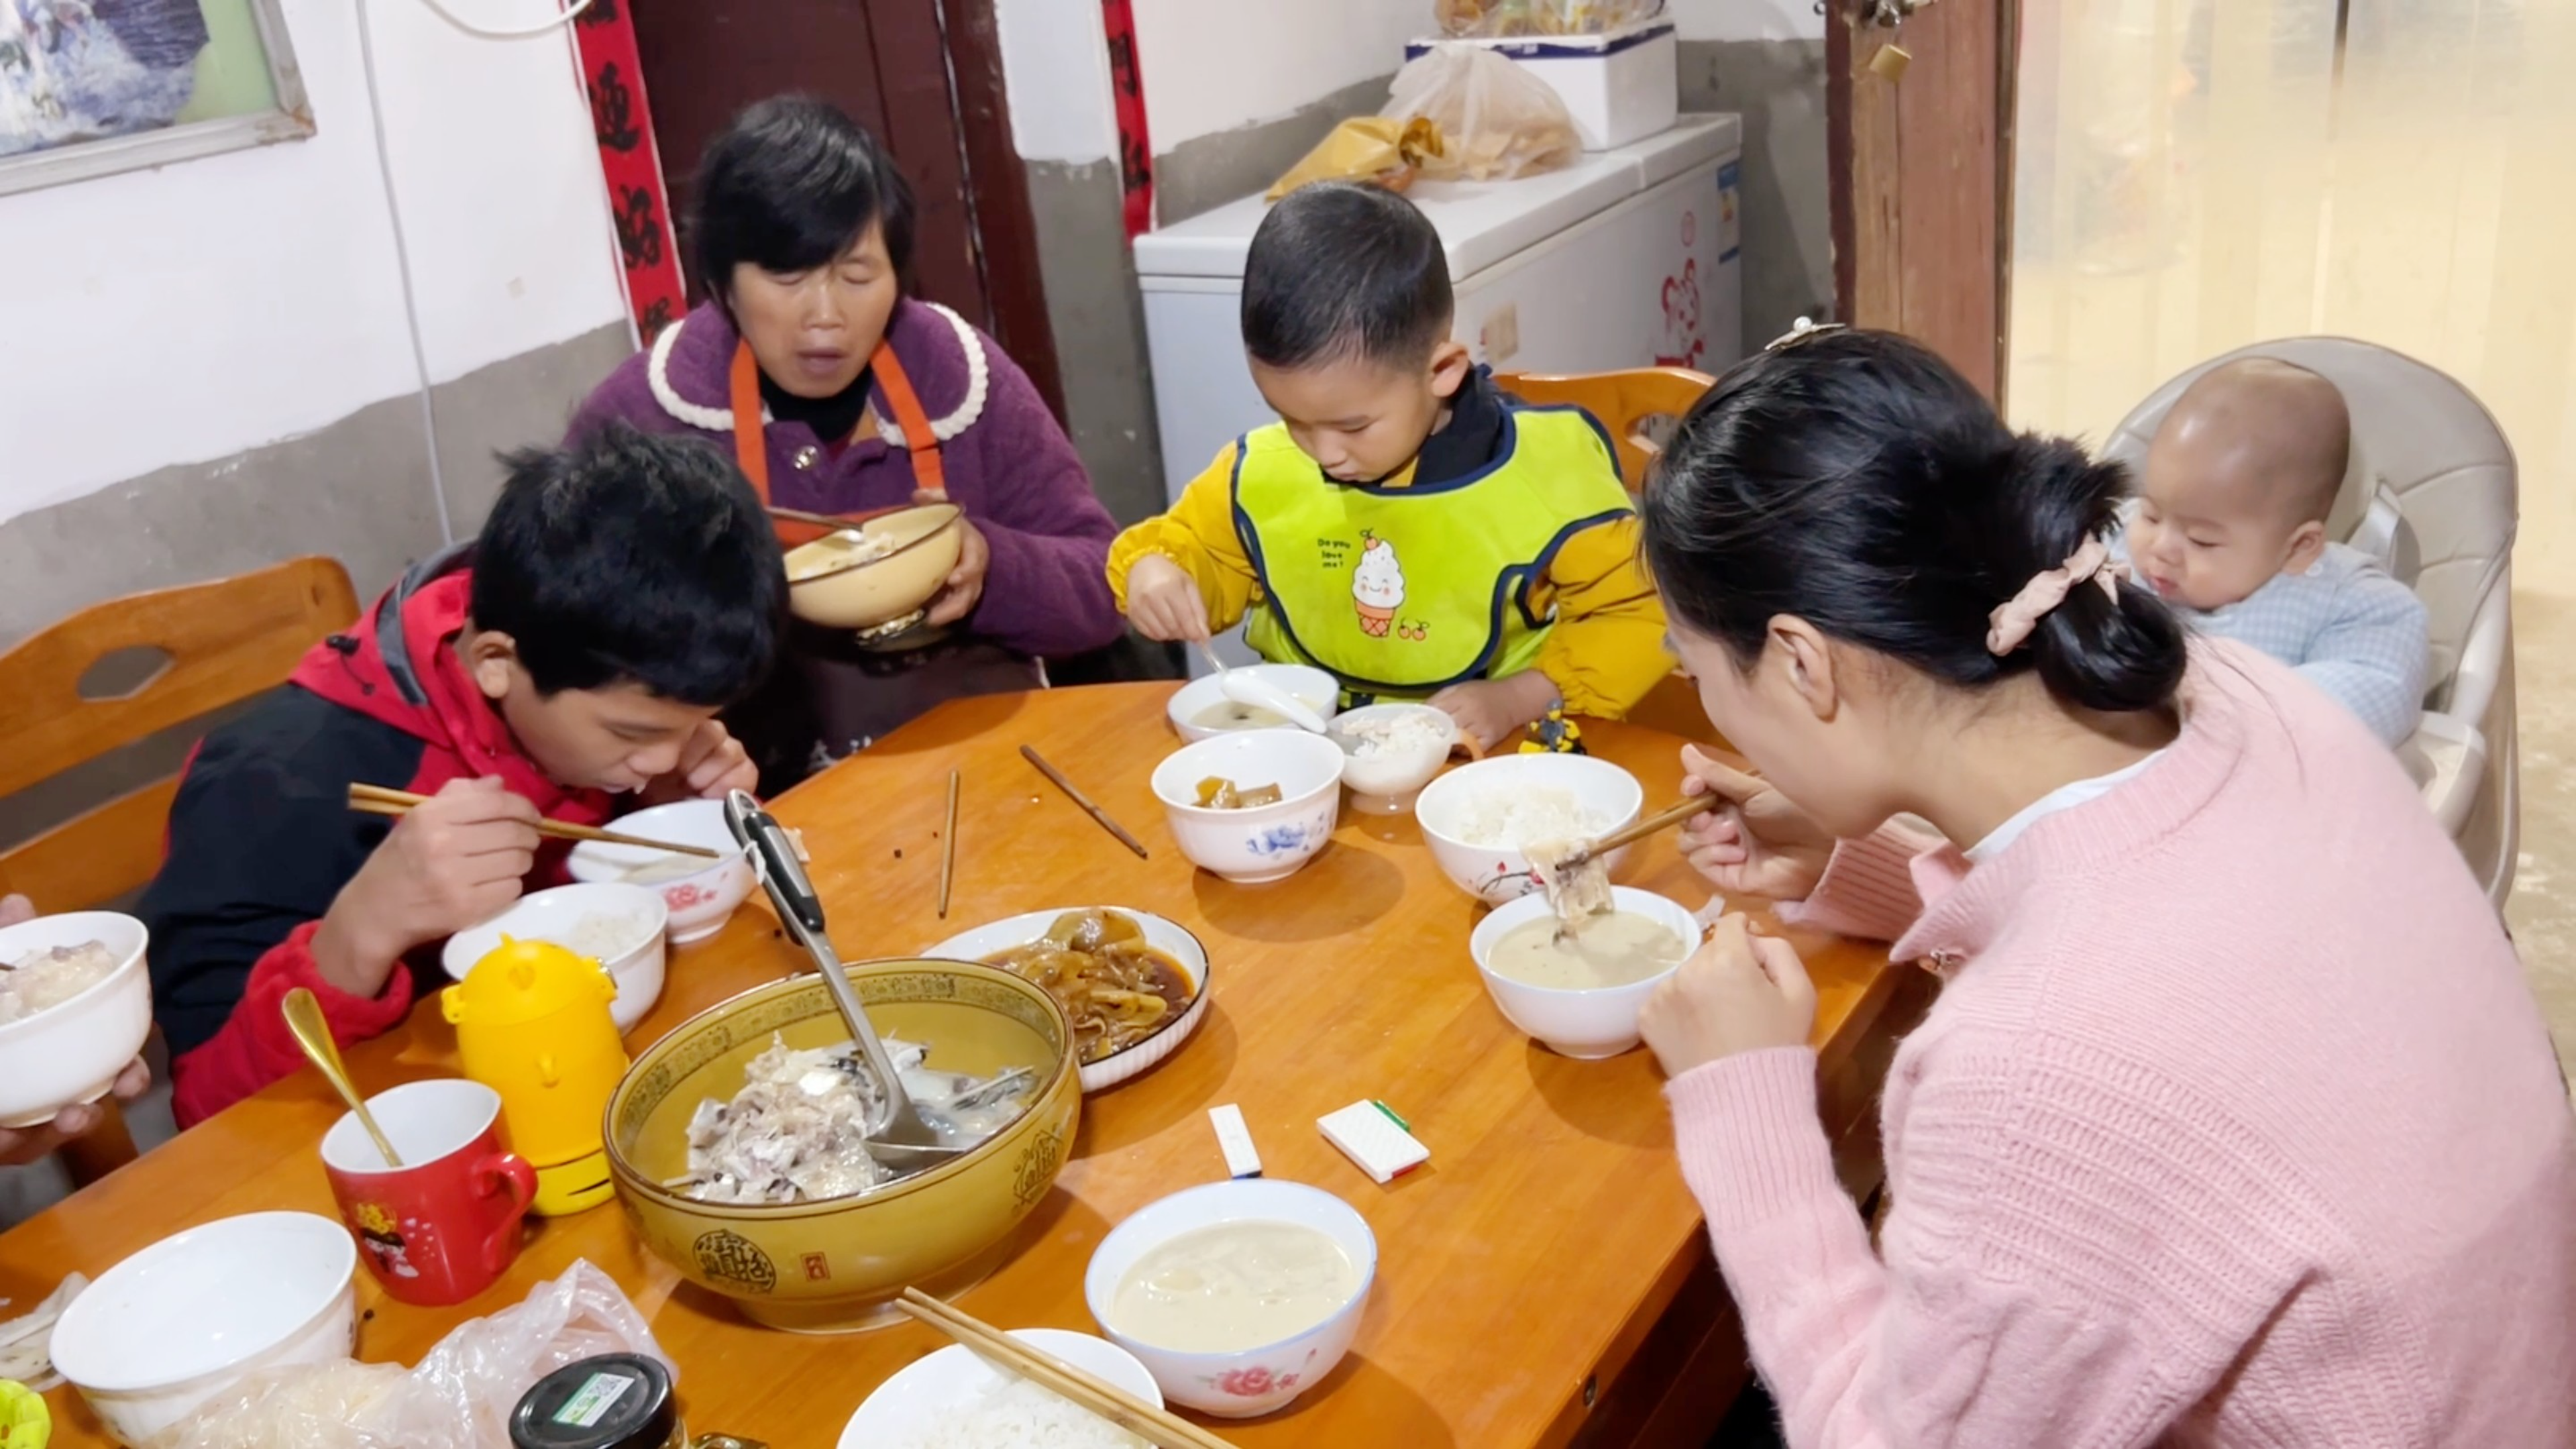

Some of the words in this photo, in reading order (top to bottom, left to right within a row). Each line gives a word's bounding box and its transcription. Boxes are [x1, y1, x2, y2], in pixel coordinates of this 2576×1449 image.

[1317, 538, 1330, 547] Do
[1332, 540, 1351, 549] you
[1322, 550, 1342, 558] love
